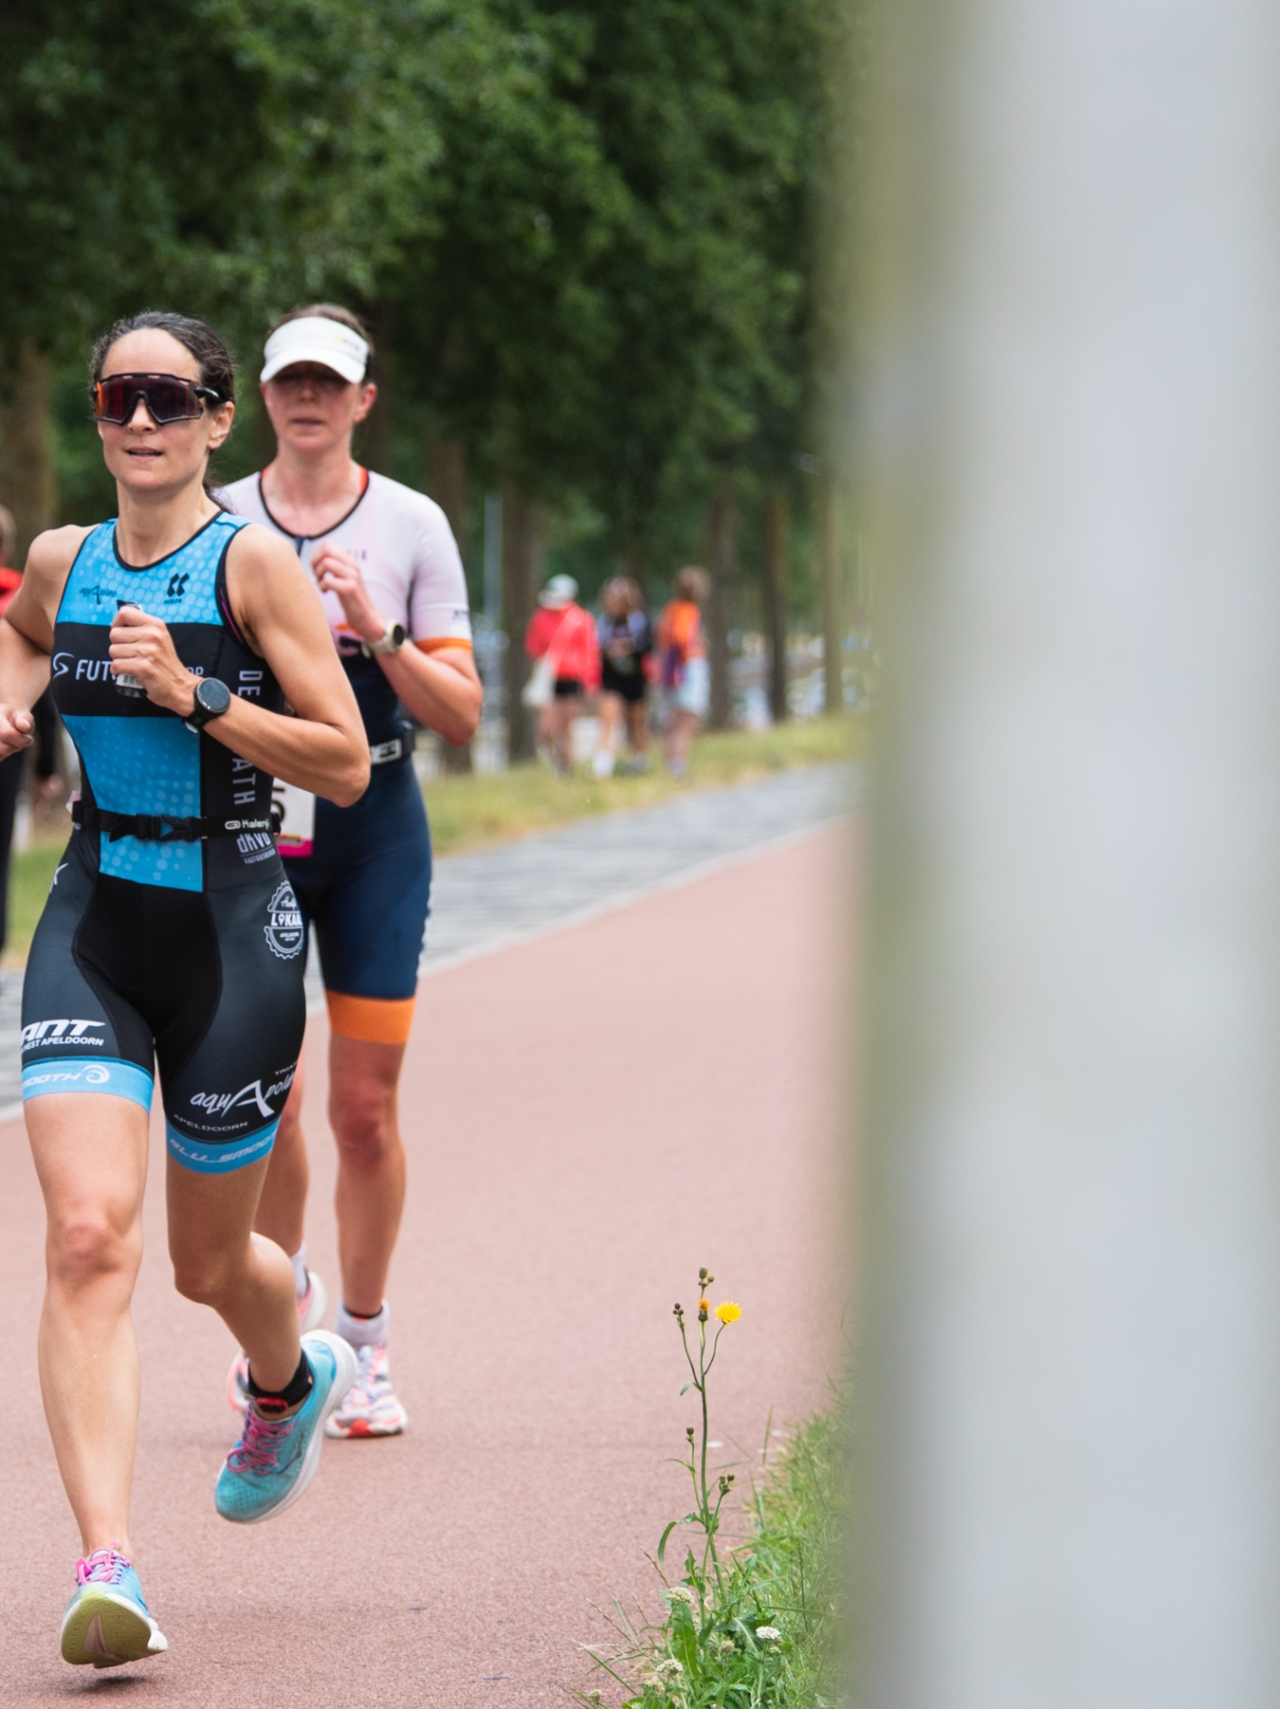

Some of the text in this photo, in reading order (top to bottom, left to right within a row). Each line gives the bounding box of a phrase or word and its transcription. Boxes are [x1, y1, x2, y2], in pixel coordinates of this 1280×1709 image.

[76, 659, 116, 681] FUT
[41, 1036, 104, 1046] APELDOORN
[173, 1114, 248, 1131] APELDOORN
